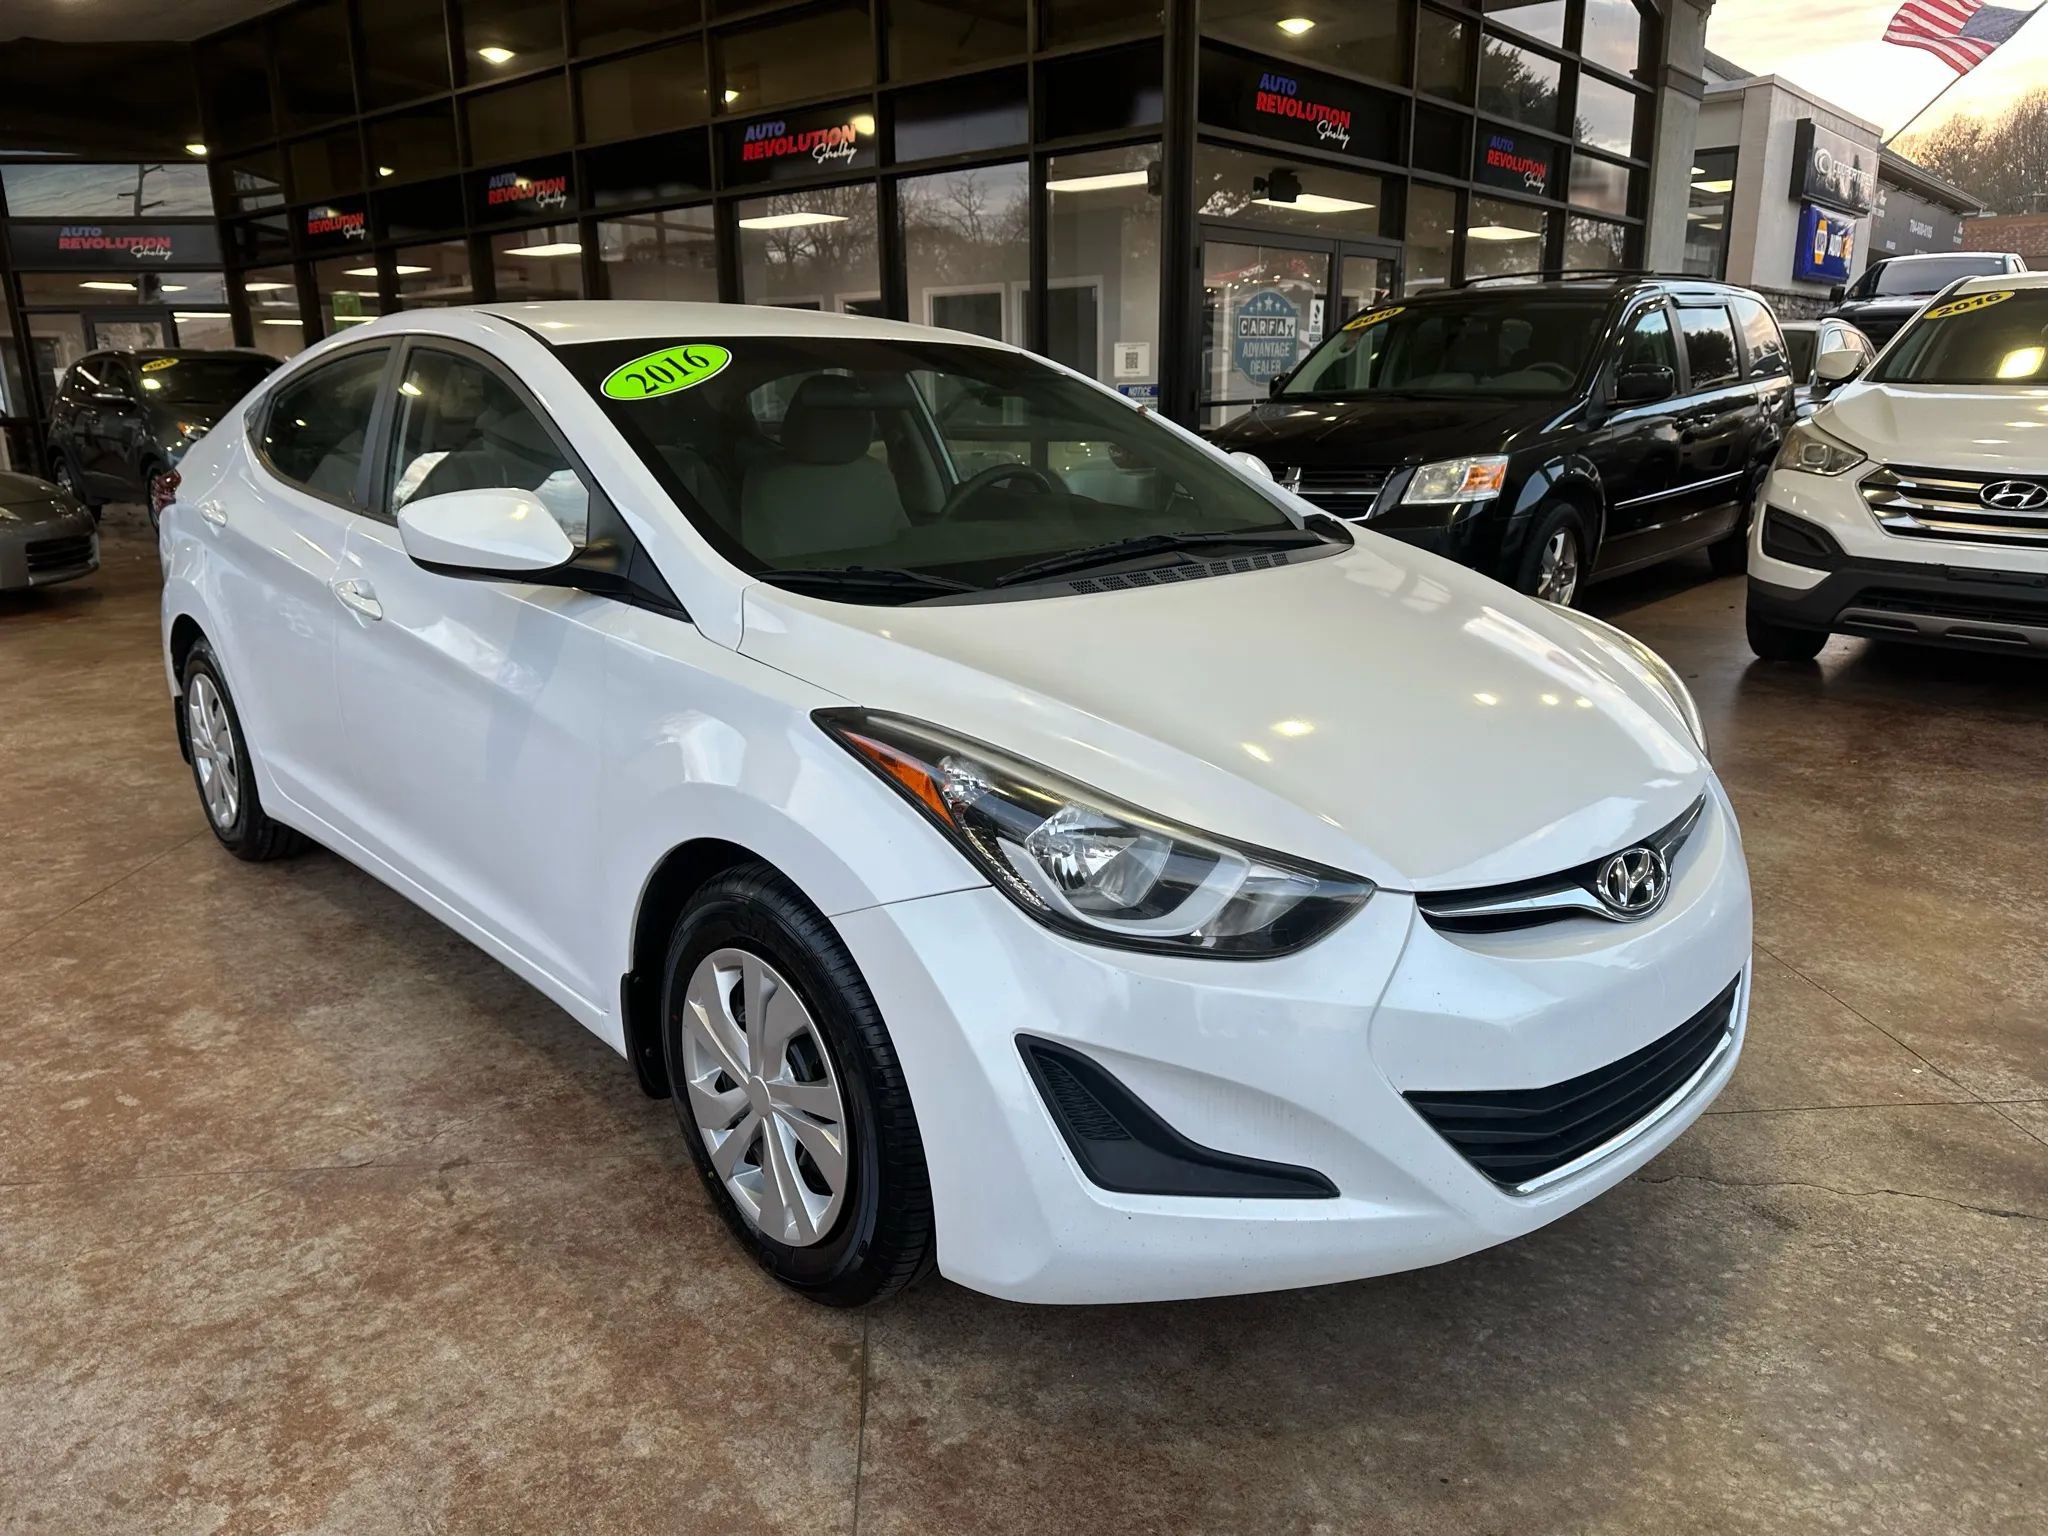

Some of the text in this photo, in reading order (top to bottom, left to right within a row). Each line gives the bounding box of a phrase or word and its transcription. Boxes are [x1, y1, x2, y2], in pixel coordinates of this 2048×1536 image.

[1260, 73, 1297, 96] AUTO
[1256, 91, 1351, 129] REVOLUTION
[743, 123, 857, 161] REVOLUTION
[745, 121, 786, 142] AUTO
[1316, 120, 1350, 150] Shelby
[812, 139, 858, 164] Shelby
[1490, 136, 1514, 152] AUTO
[1487, 149, 1546, 177] REVOLUTION
[488, 176, 566, 206] REVOLUTION
[60, 226, 102, 237] AUTO
[307, 212, 364, 234] REVOLUTION
[58, 237, 171, 249] REVOLUTION
[130, 244, 172, 260] Shelby
[1937, 293, 2003, 317] 2016
[1240, 317, 1296, 338] CARFAX
[1243, 342, 1290, 358] ADVANTAGE
[625, 348, 710, 394] 2016
[1250, 359, 1282, 376] DEALER
[1128, 386, 1152, 397] NOTICE
